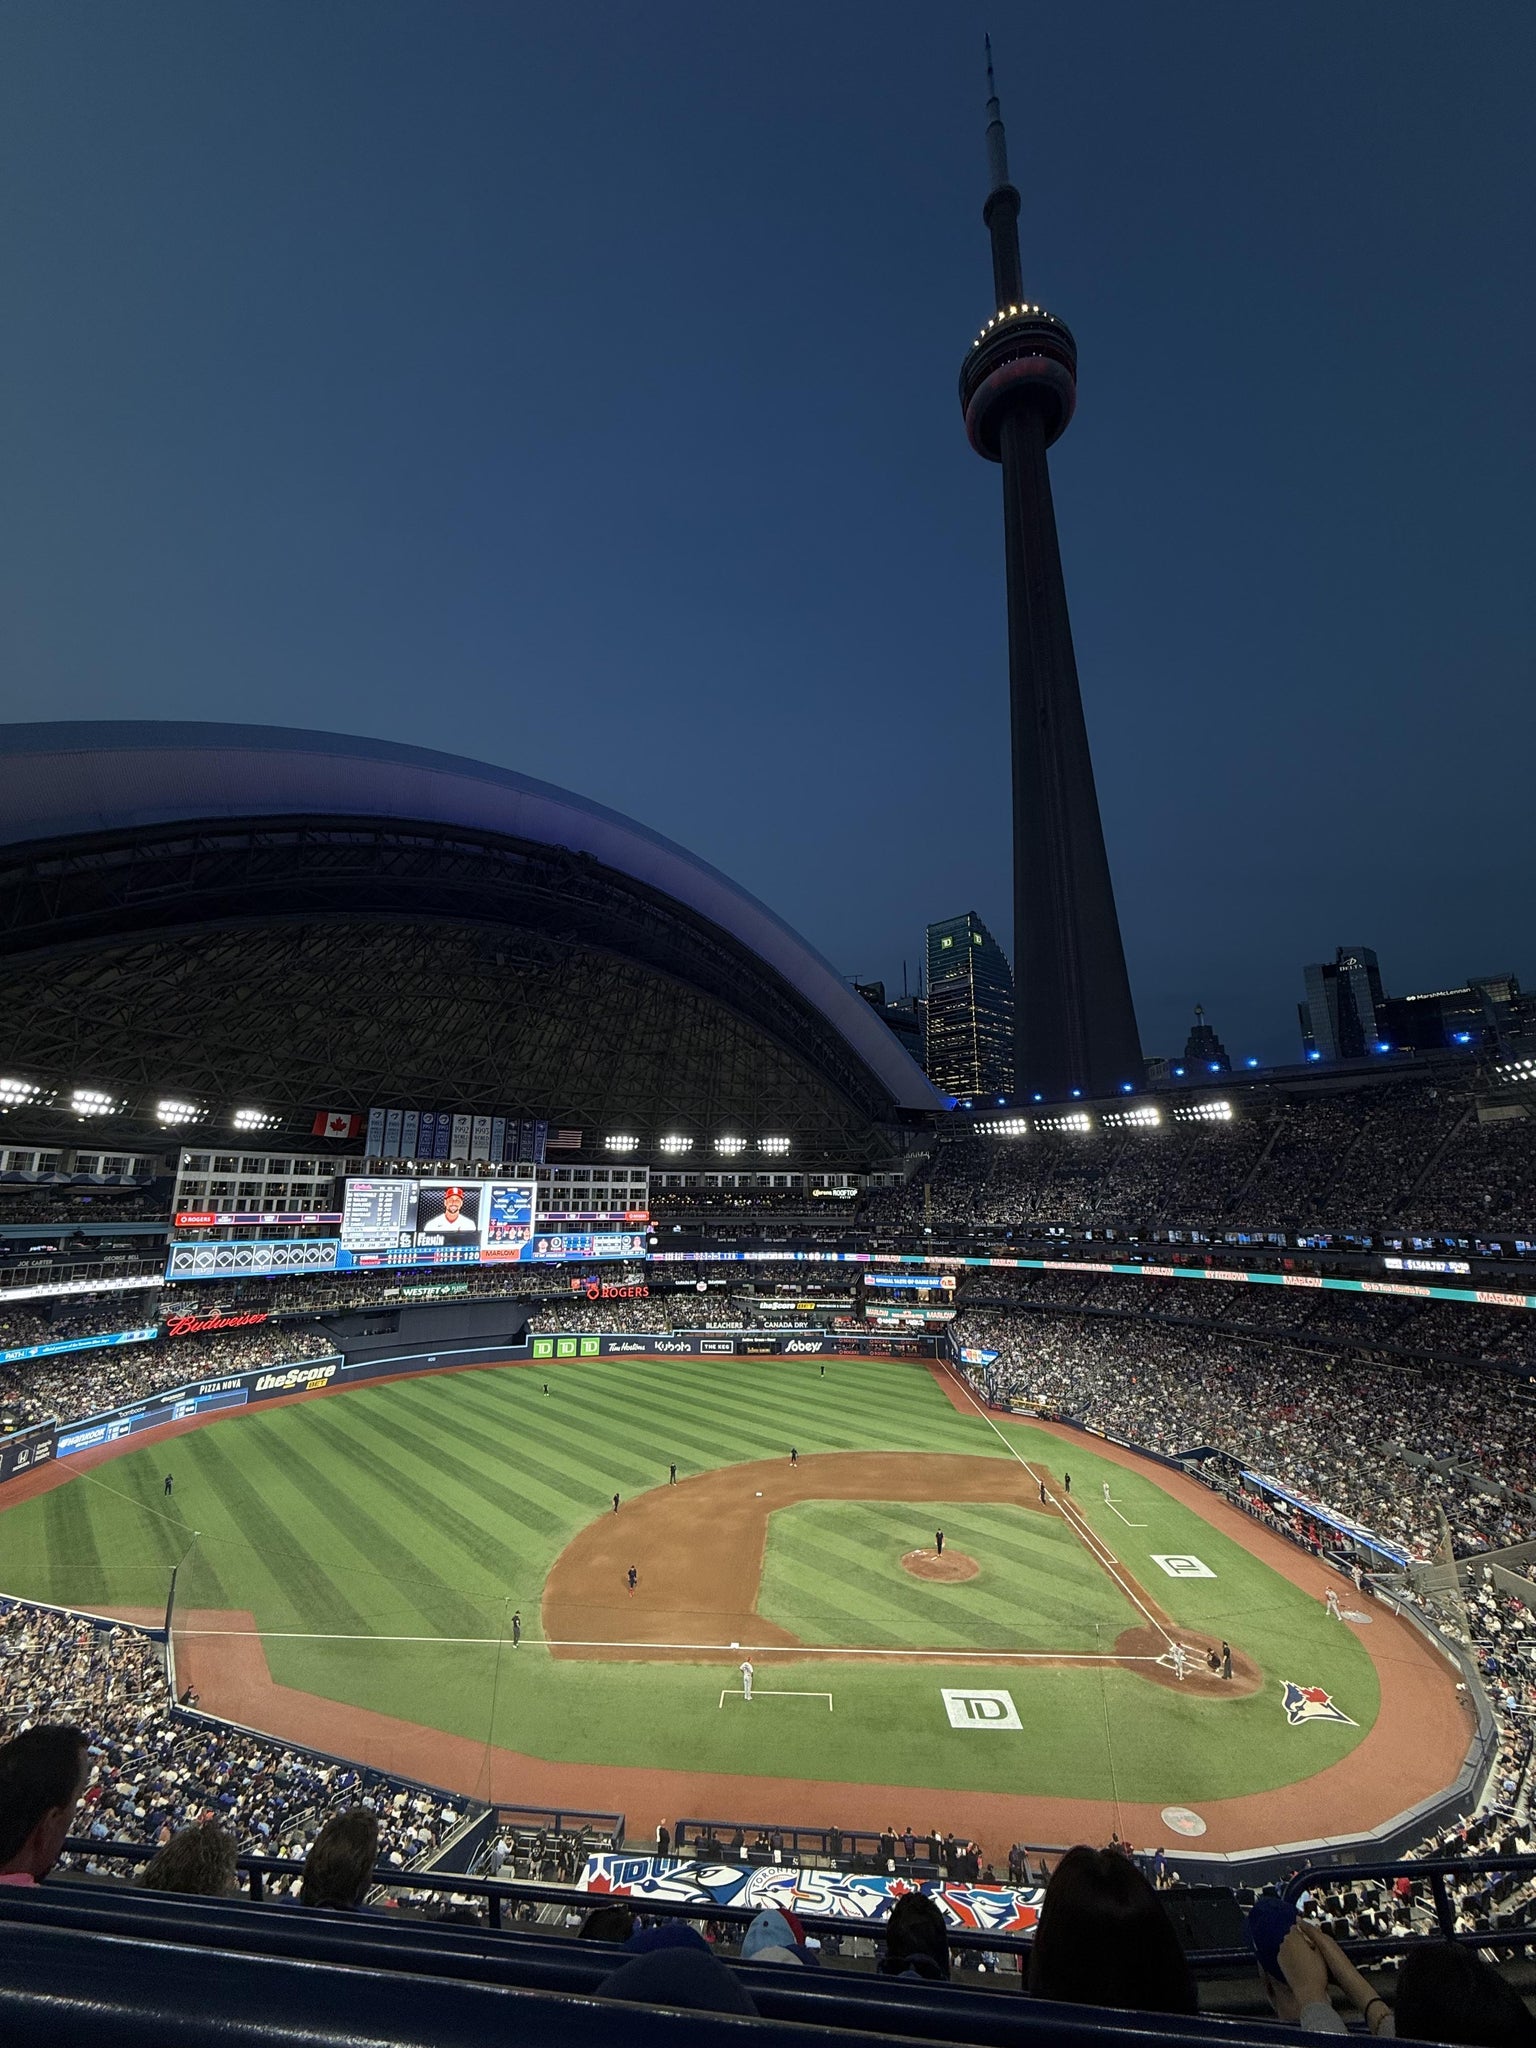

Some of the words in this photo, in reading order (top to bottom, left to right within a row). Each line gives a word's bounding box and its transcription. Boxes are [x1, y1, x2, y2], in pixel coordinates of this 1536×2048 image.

[941, 937, 952, 948] TD
[1339, 964, 1363, 972] DELTA
[1416, 987, 1471, 1000] MarshMcLennan
[454, 1126, 469, 1134] 1992
[1142, 1266, 1174, 1276] MARLOW
[1283, 1276, 1322, 1288] MARLOW
[403, 1287, 441, 1296] WESTJET
[601, 1286, 649, 1298] ROGERS
[1476, 1292, 1526, 1306] MARLOW
[760, 1302, 796, 1310] theScore
[166, 1312, 268, 1336] Budweiser
[536, 1343, 551, 1354] TD
[560, 1342, 574, 1353] TD
[583, 1341, 598, 1352] TD
[608, 1342, 620, 1352] Tim
[621, 1342, 646, 1351] Hortons
[654, 1341, 691, 1351] Kubota
[785, 1340, 822, 1353] Sobeys
[5, 1351, 25, 1359] PATH
[255, 1365, 336, 1391] theScore
[199, 1382, 221, 1394] PIZZA
[222, 1379, 241, 1390] NOVA
[1164, 1558, 1200, 1574] TD
[951, 1697, 1008, 1720] TD
[753, 1867, 798, 1888] TORONTO
